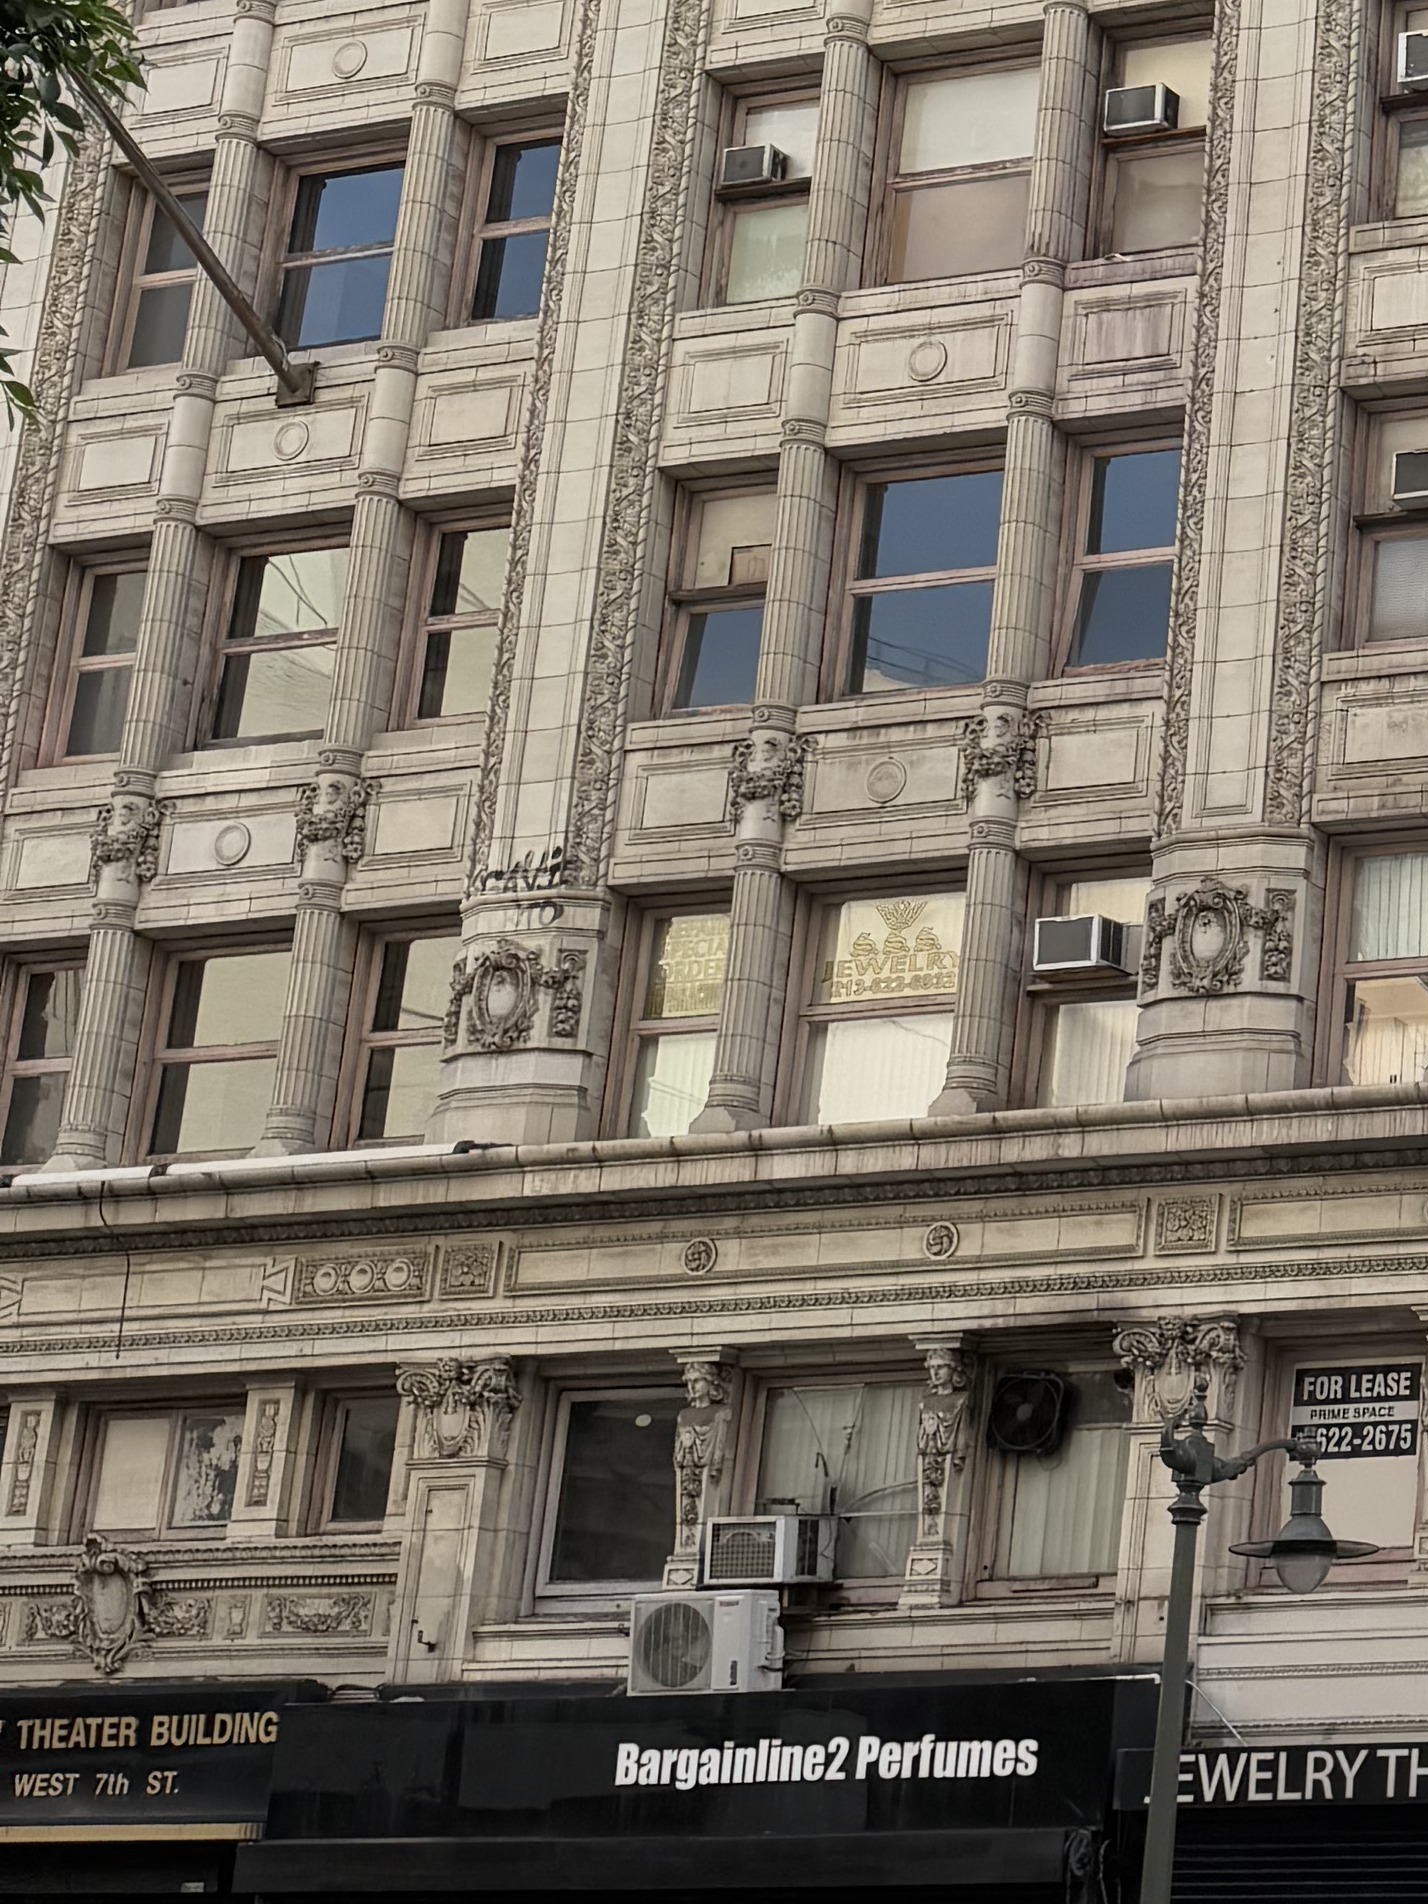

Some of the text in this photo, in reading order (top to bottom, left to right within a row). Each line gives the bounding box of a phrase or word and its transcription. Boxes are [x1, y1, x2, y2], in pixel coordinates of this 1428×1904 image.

[1303, 1371, 1411, 1400] FOR LEASE
[1310, 1406, 1395, 1421] PRIME SPACE
[17, 1717, 138, 1750] THEATER
[150, 1711, 280, 1746] BUILDING
[615, 1733, 1038, 1791] Bargainline2 Perfumes
[1144, 1749, 1368, 1803] EWELRY
[15, 1770, 180, 1797] WEST 7th ST.
